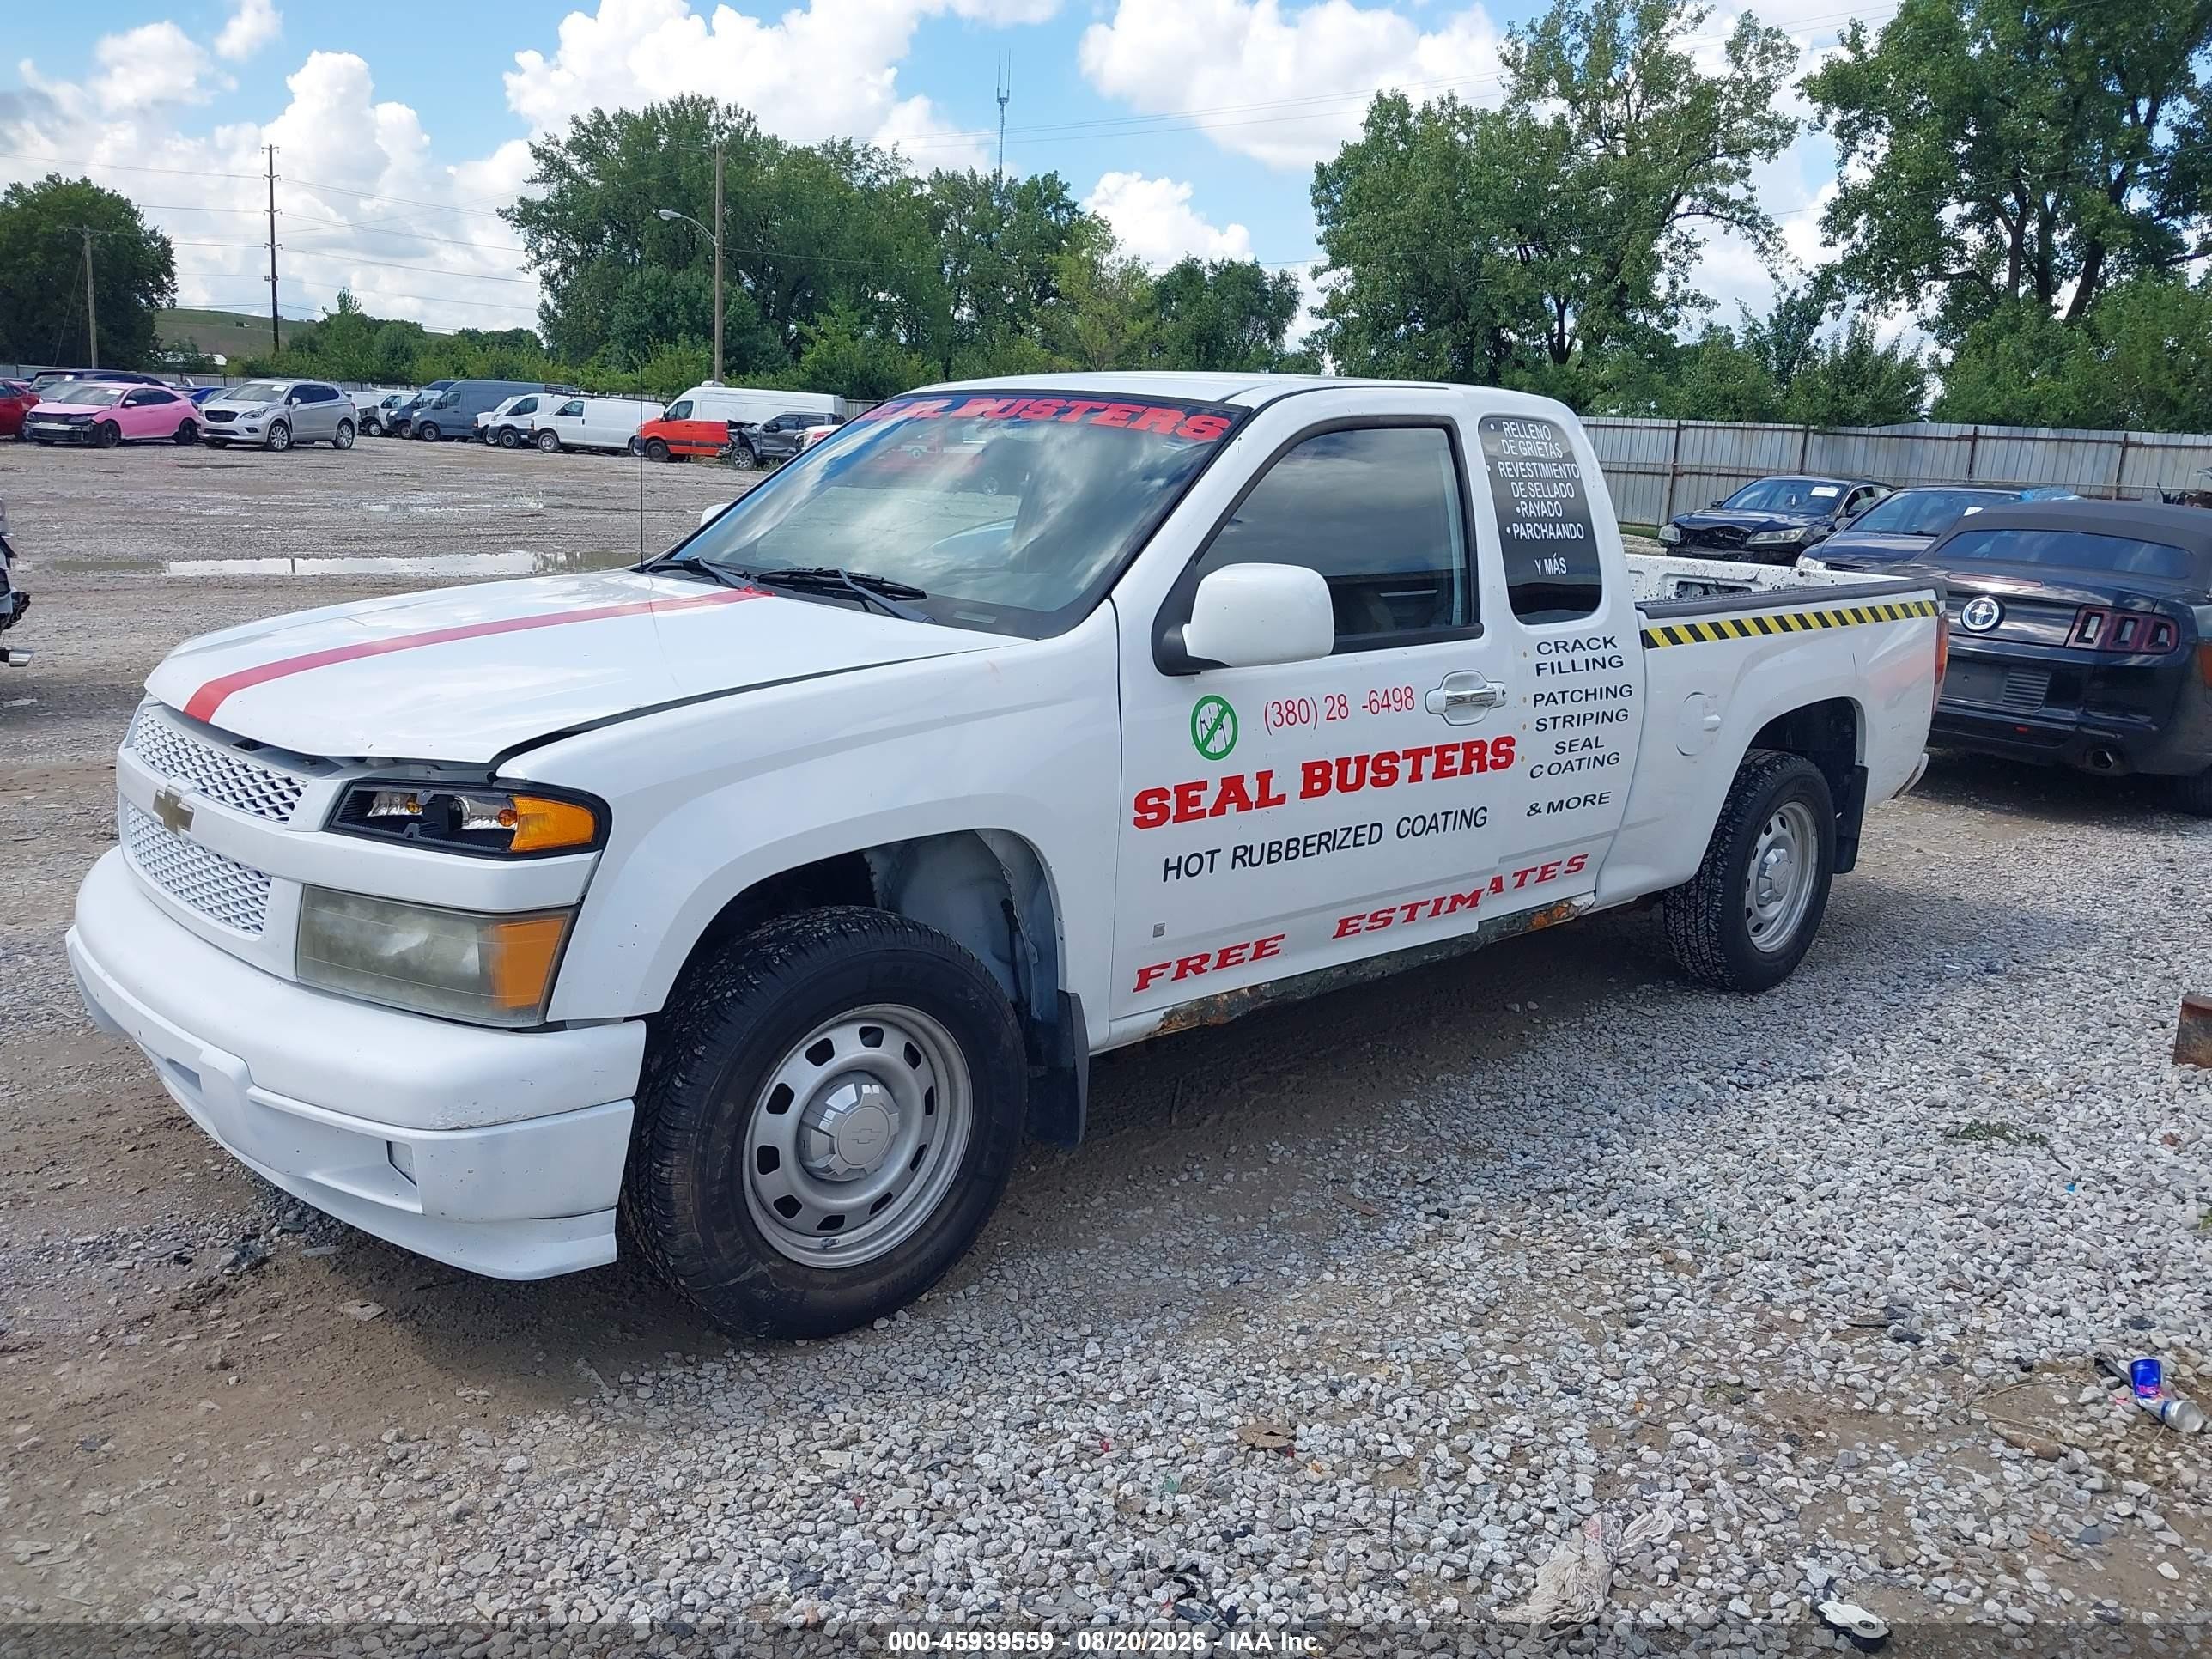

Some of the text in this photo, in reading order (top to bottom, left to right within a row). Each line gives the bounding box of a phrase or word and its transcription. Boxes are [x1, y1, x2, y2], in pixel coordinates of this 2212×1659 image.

[949, 398, 1231, 440] BUSTERS
[1503, 422, 1551, 441] RELLENO
[1502, 440, 1563, 458] DE GRIETAS
[1498, 461, 1579, 479] REVESTIMIENTO
[1511, 482, 1575, 499] DE SELLADO
[1521, 501, 1562, 518] RAYADO
[1512, 523, 1584, 540] PARCHAANDO
[1534, 552, 1567, 575] Y MÁS
[1536, 635, 1619, 655] CRACK
[1535, 655, 1624, 677] FILLING
[1533, 684, 1632, 708] PATCHING
[1264, 686, 1415, 736] (380) 28 -6498
[1535, 708, 1629, 732] STRIPING
[1554, 736, 1605, 755] SEAL
[1529, 752, 1620, 779] COATING
[1133, 735, 1516, 830] SEAL BUSTERS
[1162, 806, 1487, 883] HOT RUBBERIZED COATING
[1133, 853, 1589, 993] FREE ESTIMATES
